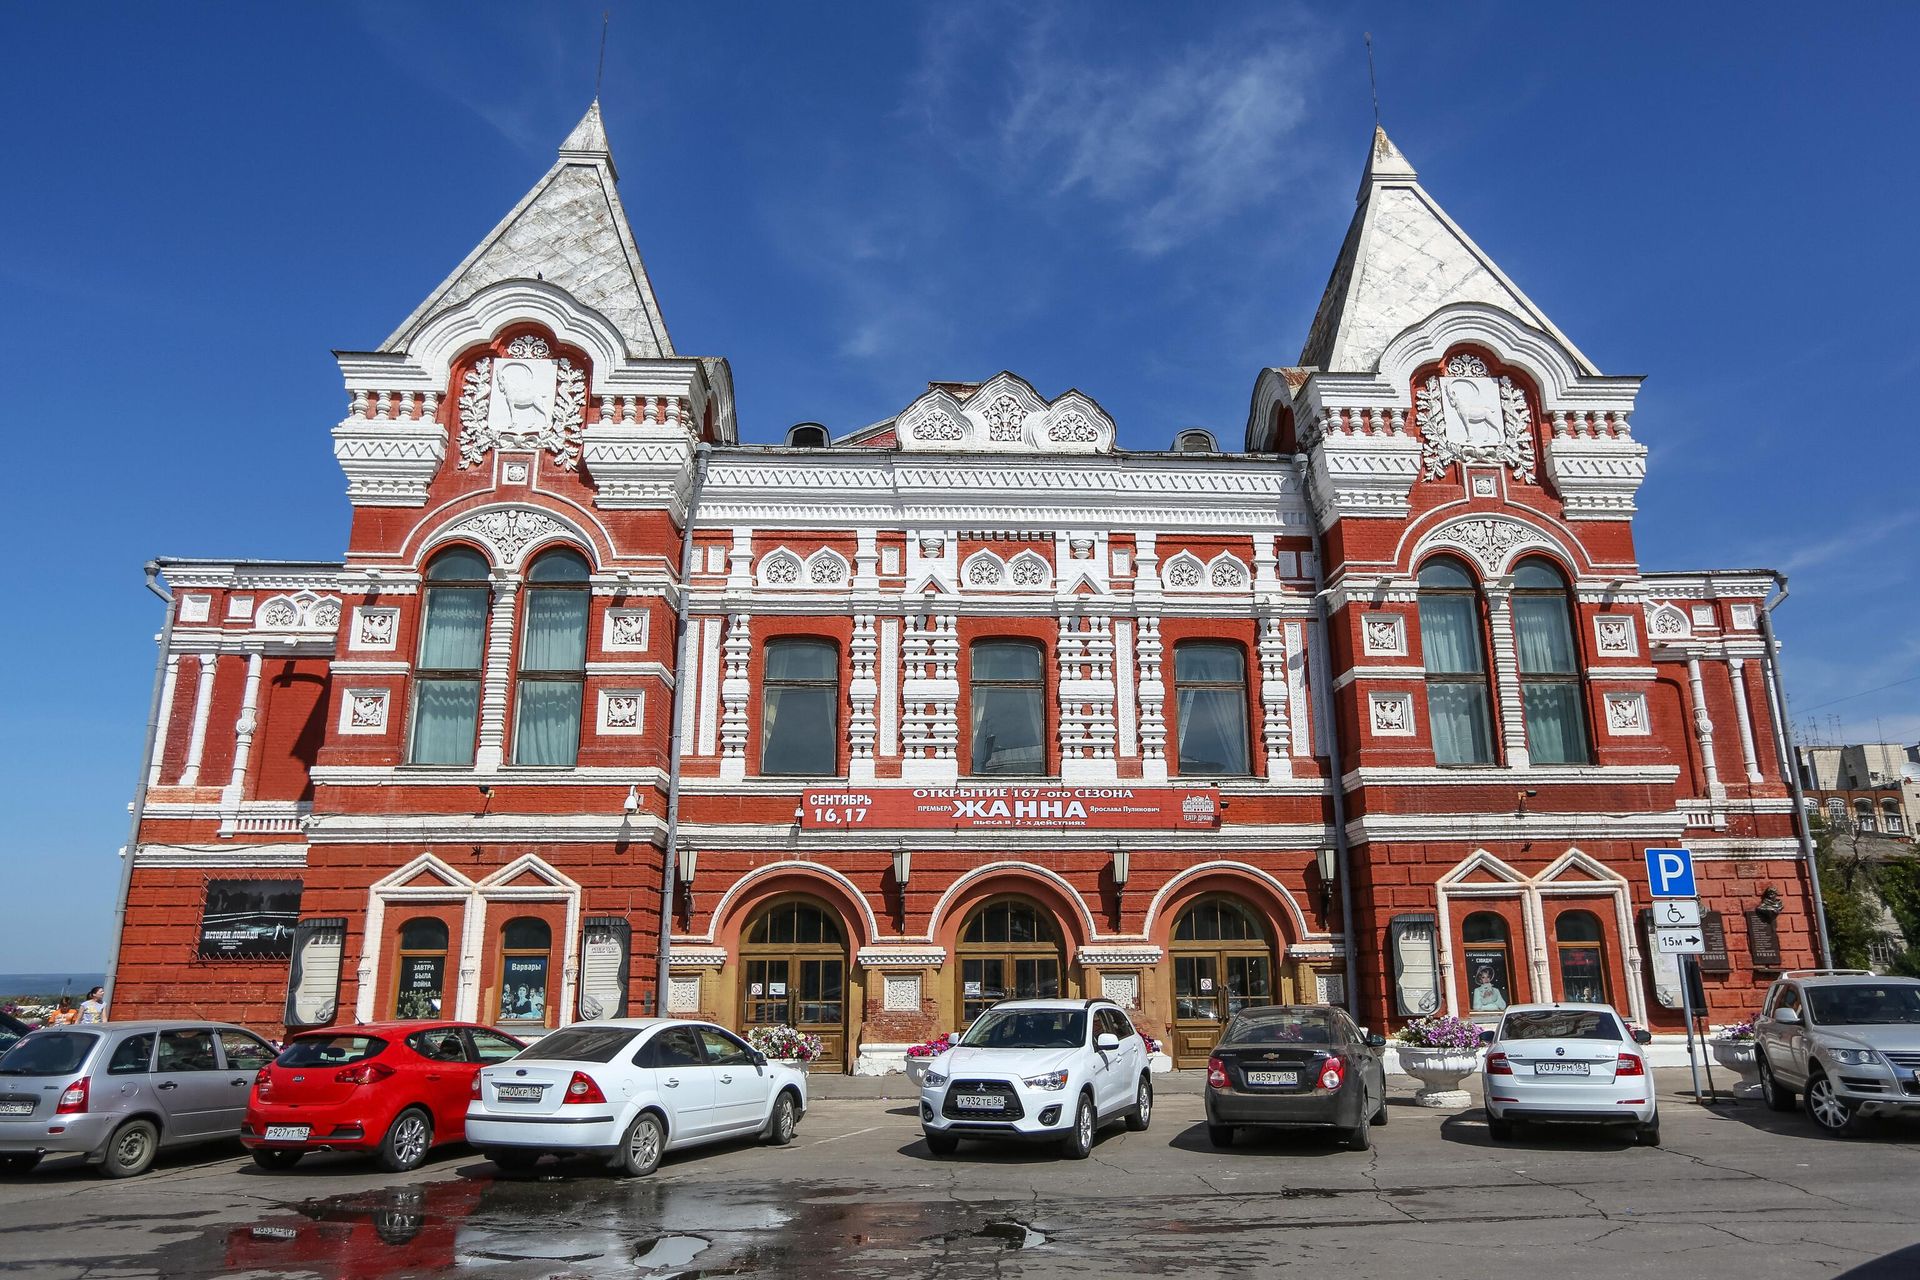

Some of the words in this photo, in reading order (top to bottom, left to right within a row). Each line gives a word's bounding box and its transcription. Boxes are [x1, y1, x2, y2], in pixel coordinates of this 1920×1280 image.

[913, 789, 1009, 798] ОТКРЫТИЕ
[1013, 789, 1071, 798] 167-ого
[1074, 789, 1134, 798] СЕЗОНА
[810, 795, 872, 805] СЕНТЯБРЬ
[951, 800, 1088, 818] ЖАННА
[1090, 805, 1121, 813] Ярослава
[815, 808, 867, 824] 16,17
[1658, 854, 1684, 891] P
[511, 963, 541, 971] Варвары
